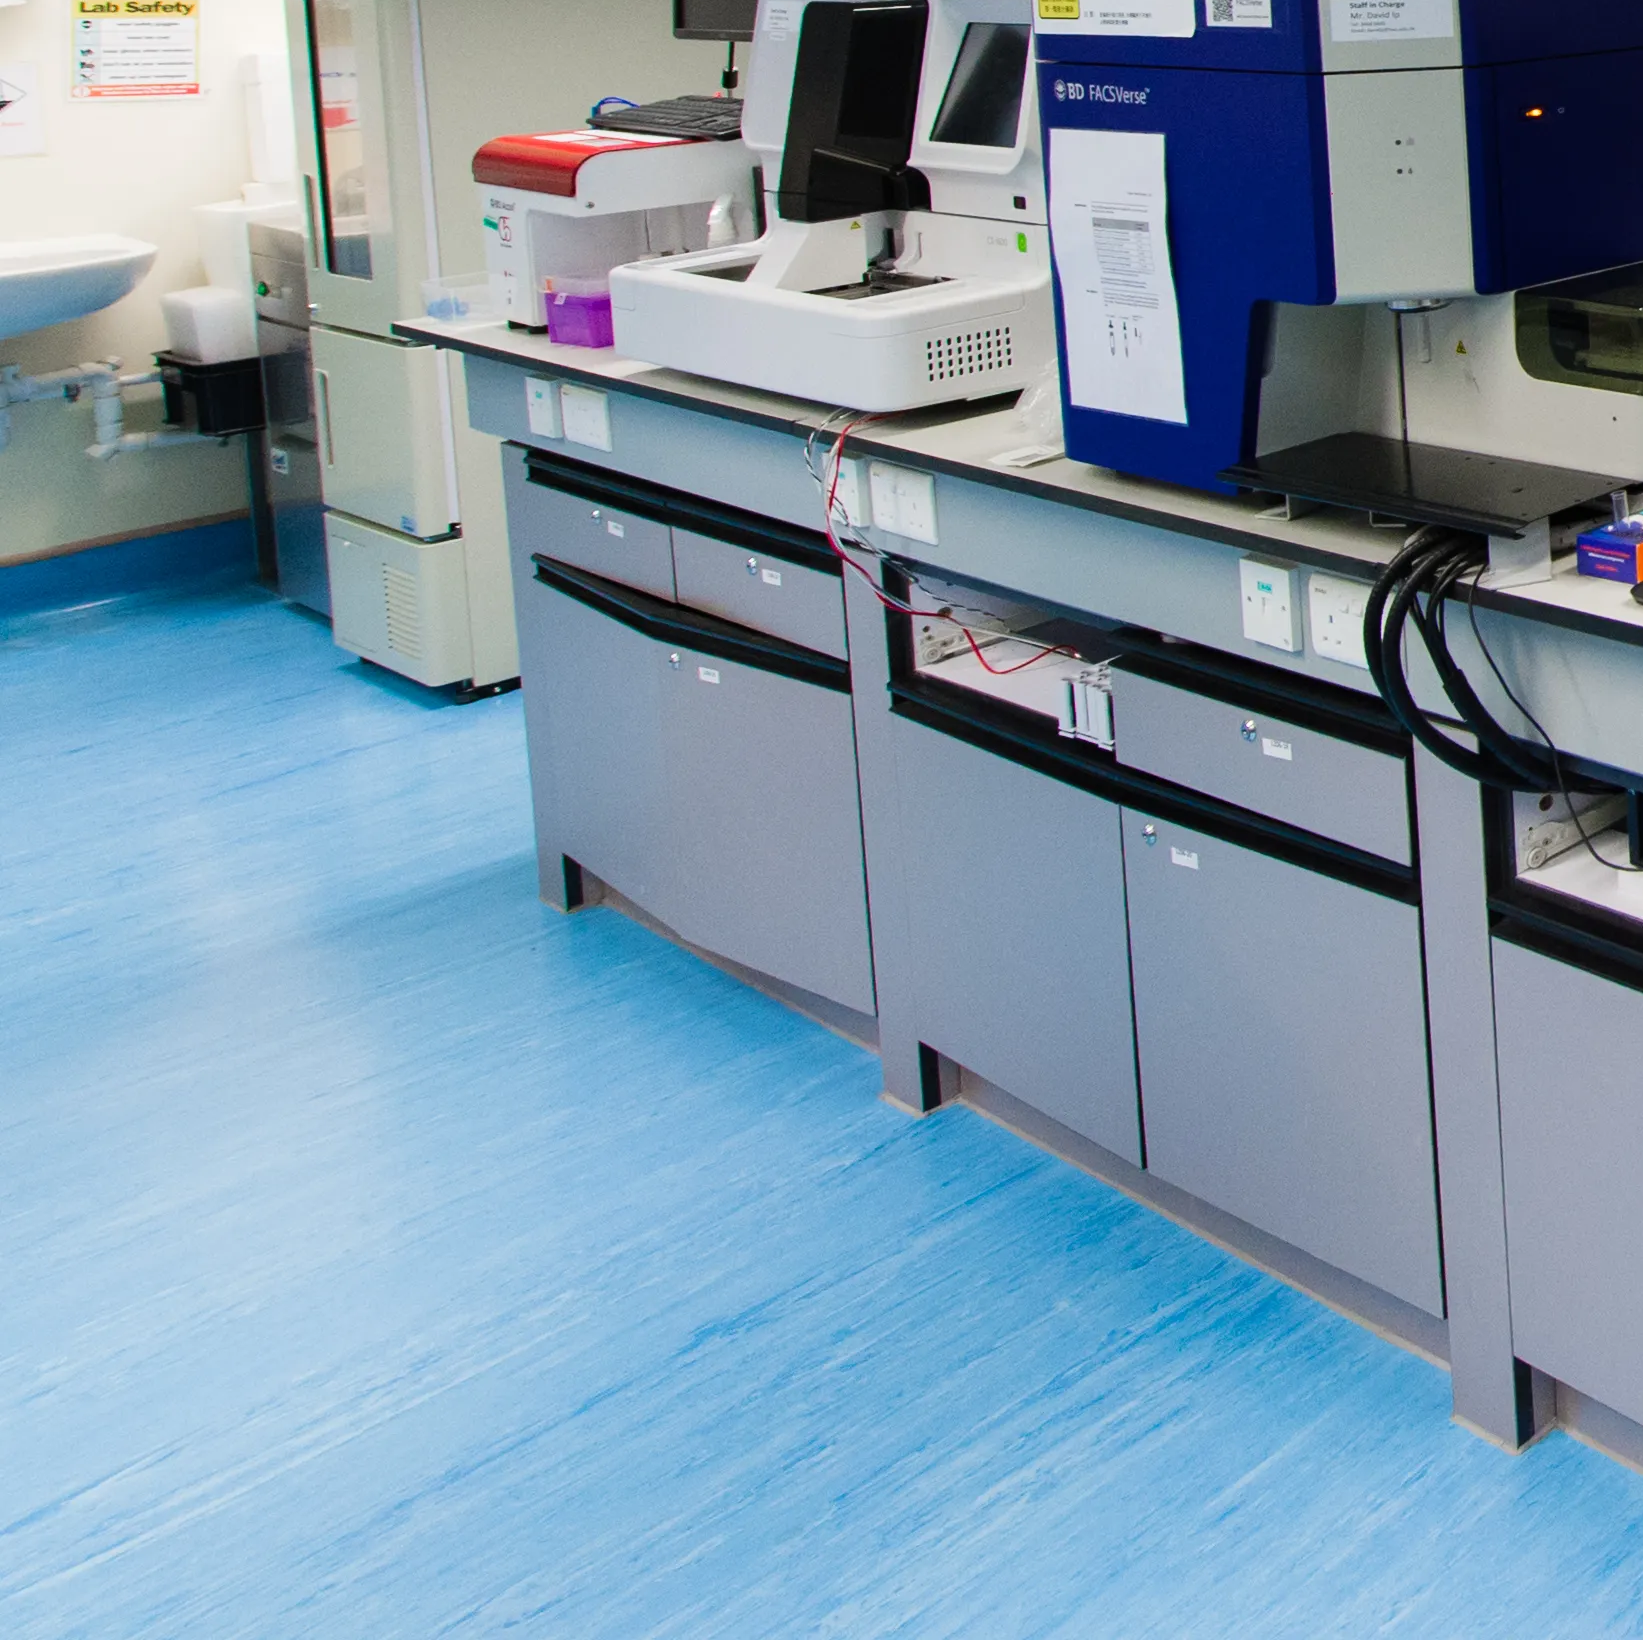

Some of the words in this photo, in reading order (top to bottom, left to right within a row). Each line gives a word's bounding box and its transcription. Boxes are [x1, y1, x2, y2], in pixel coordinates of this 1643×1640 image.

[80, 1, 119, 13] Lab
[125, 0, 195, 15] Safety
[1349, 1, 1368, 9] Staff
[1378, 1, 1405, 9] Charge
[1067, 82, 1085, 100] BD
